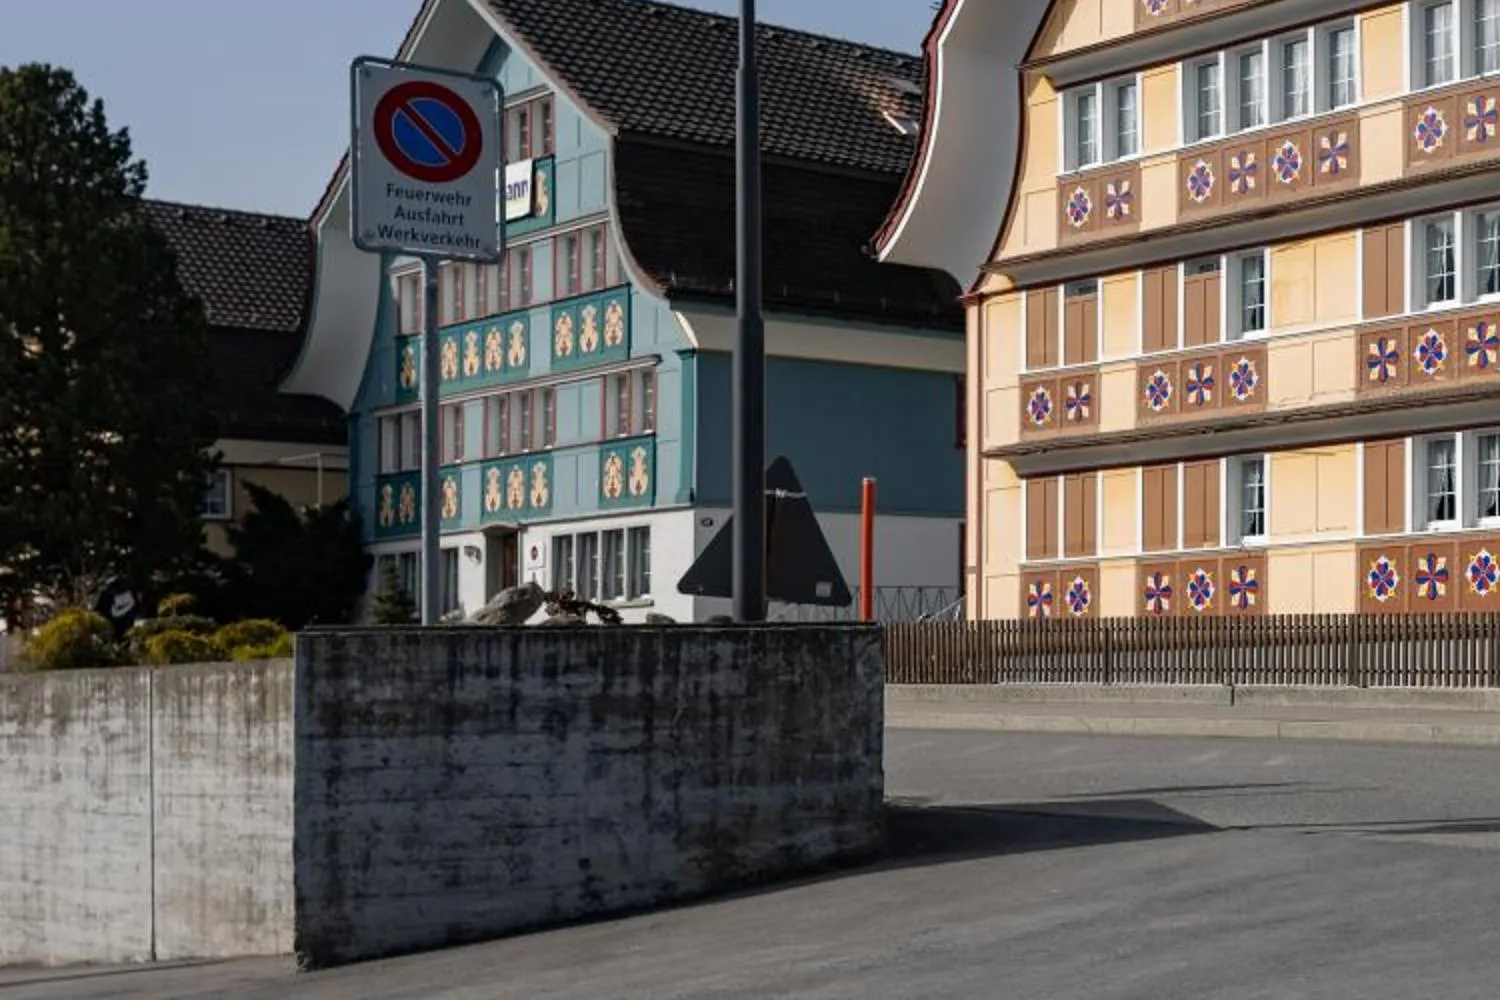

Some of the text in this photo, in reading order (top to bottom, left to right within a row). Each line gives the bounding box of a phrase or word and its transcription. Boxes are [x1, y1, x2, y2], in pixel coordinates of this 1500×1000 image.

[386, 183, 472, 206] Feuerwehr
[505, 179, 528, 200] ann
[394, 204, 465, 226] Ausfahrt
[377, 224, 480, 249] Werkverkehr
